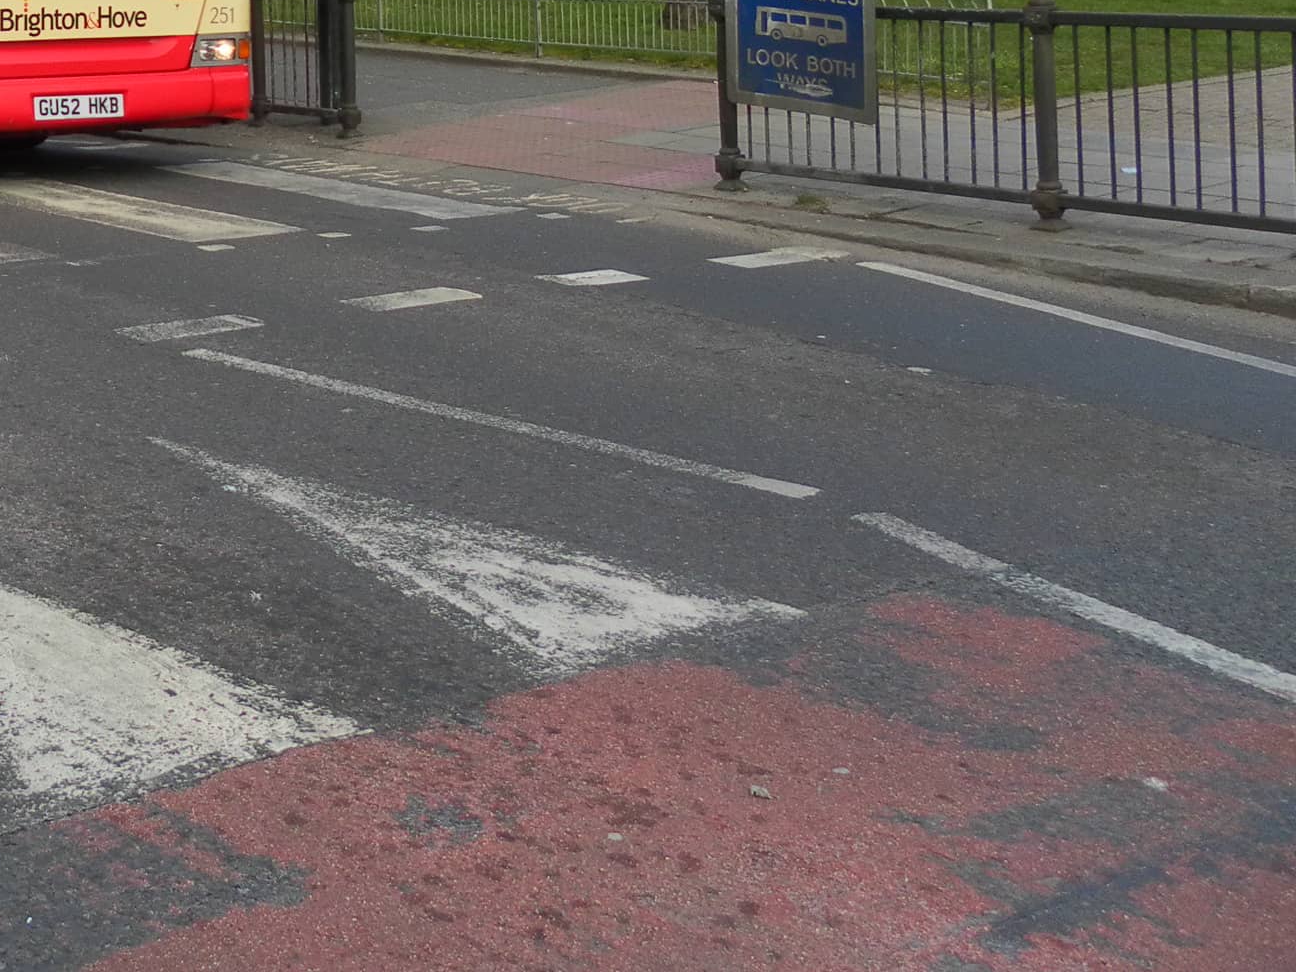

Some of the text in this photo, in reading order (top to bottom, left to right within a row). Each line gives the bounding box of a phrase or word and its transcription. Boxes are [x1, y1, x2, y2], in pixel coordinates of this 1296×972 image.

[210, 7, 235, 24] 251
[747, 47, 856, 78] LOOK BOTH
[39, 96, 119, 116] GU52 HKB
